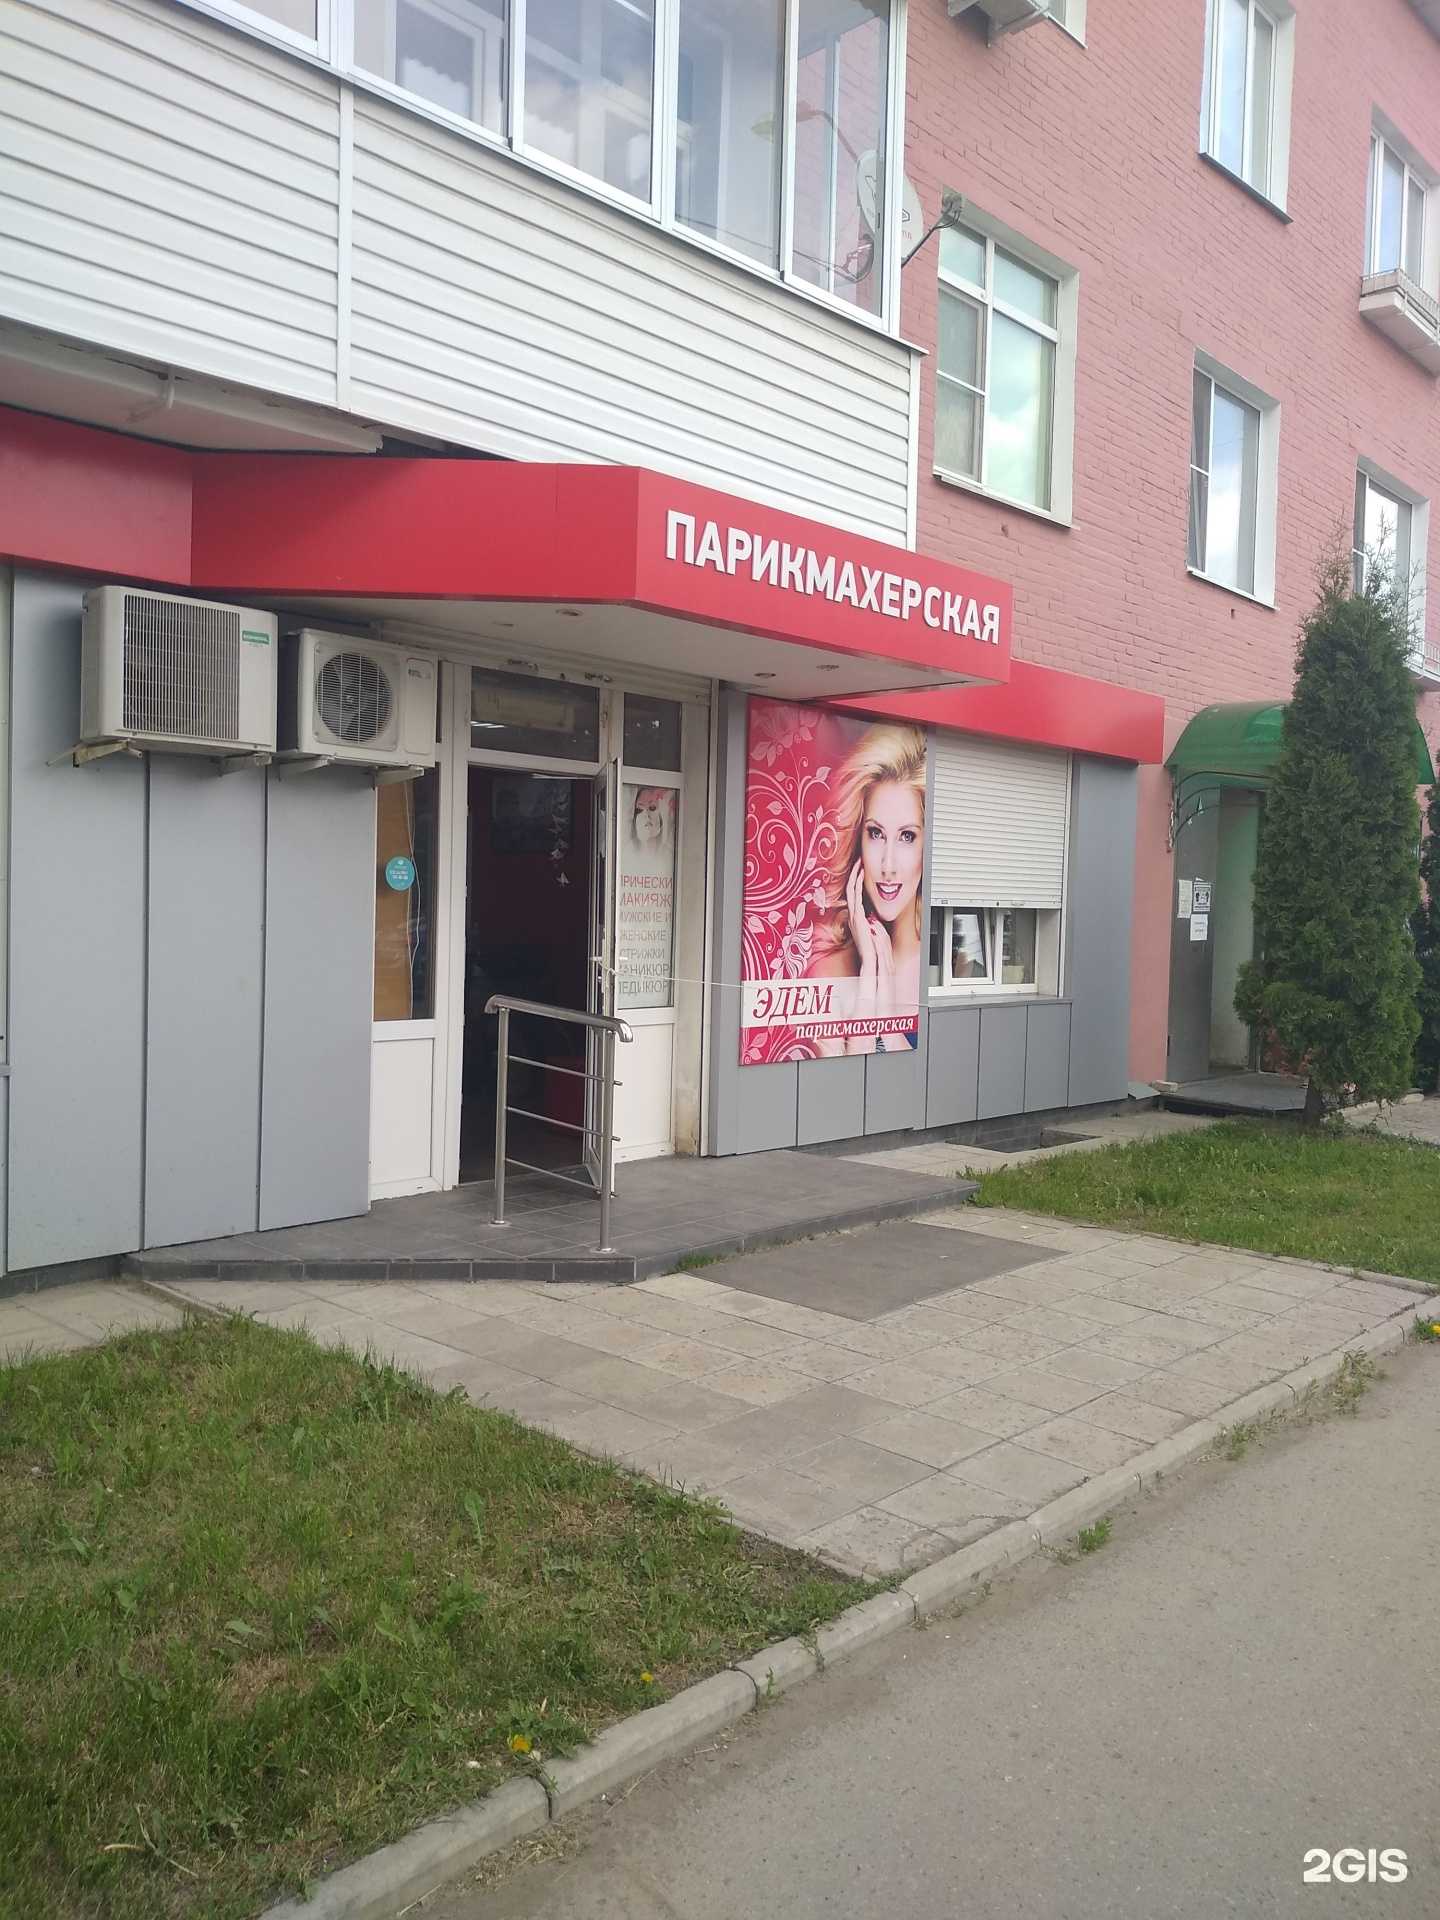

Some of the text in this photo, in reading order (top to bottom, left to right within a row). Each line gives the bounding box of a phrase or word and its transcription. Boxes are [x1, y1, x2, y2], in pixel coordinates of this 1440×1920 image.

[665, 509, 1001, 645] ПАРИКМАХЕРСКАЯ
[752, 984, 834, 1025] ЭДЕМ
[795, 1017, 914, 1042] парикмахерская
